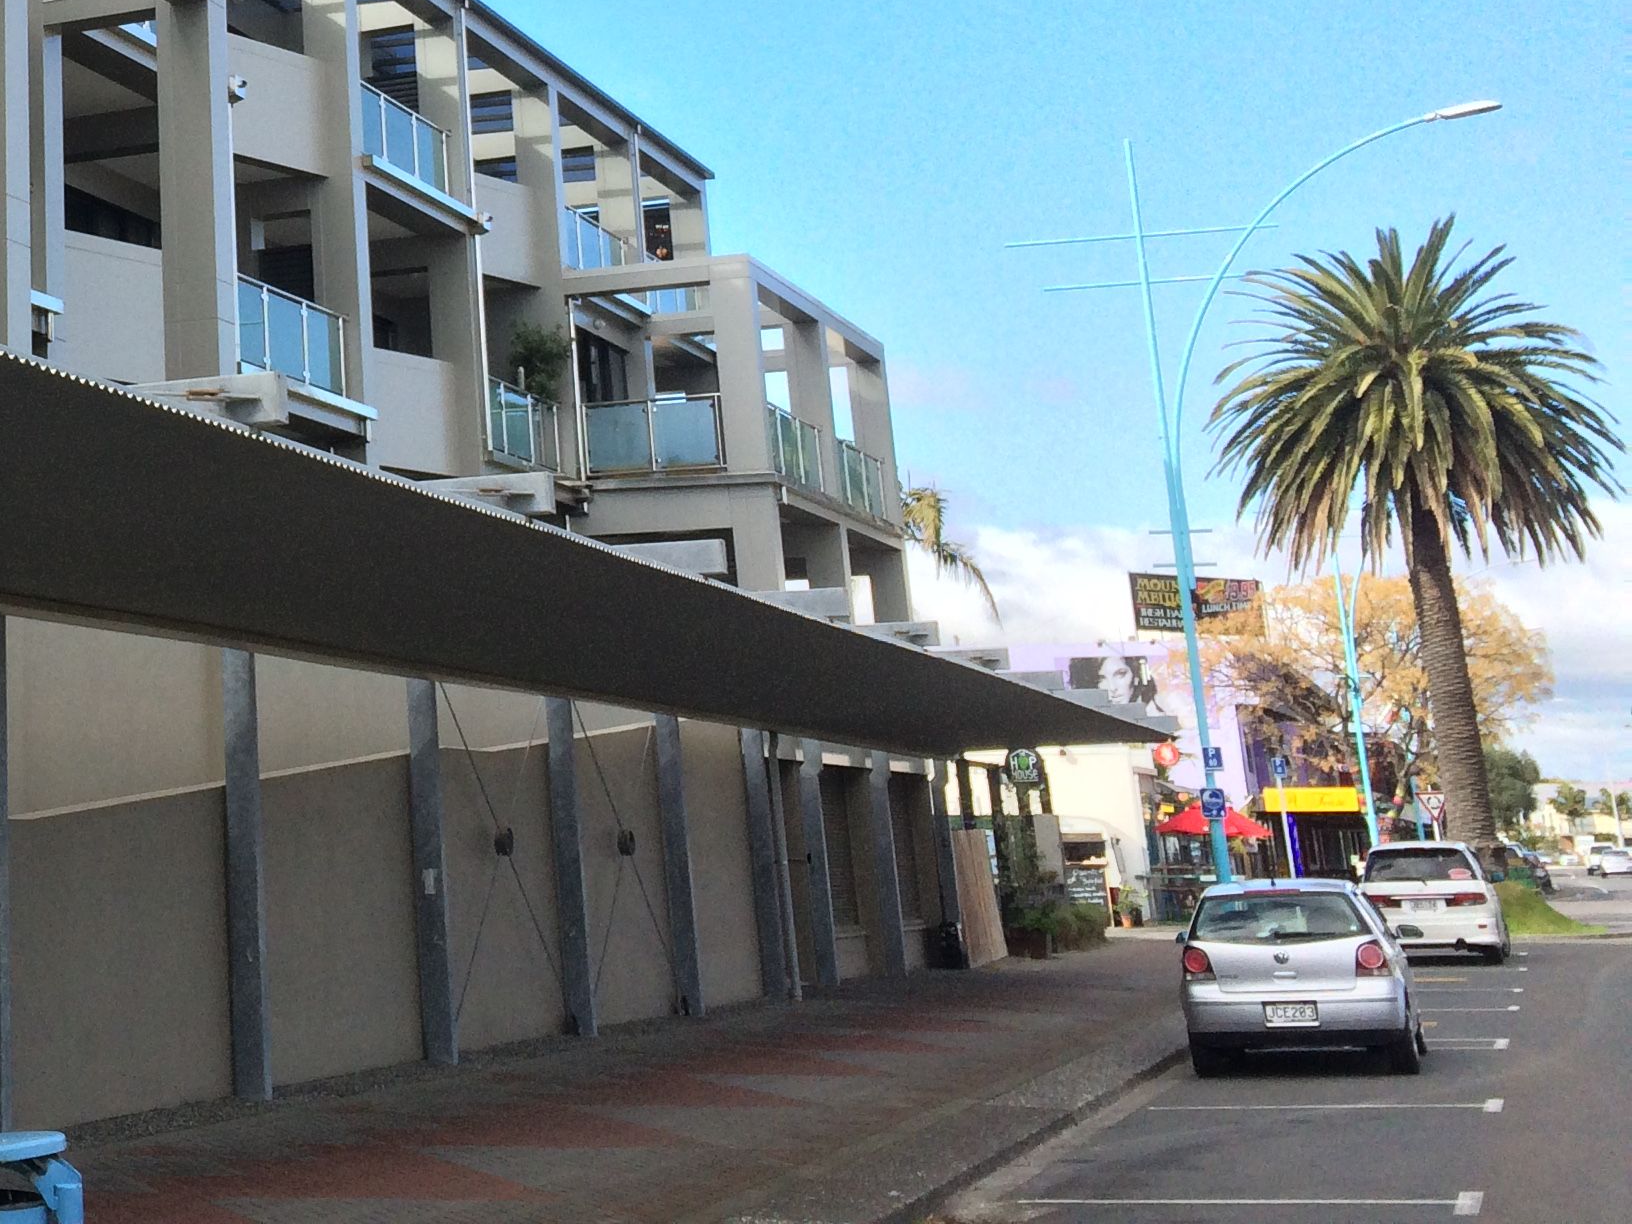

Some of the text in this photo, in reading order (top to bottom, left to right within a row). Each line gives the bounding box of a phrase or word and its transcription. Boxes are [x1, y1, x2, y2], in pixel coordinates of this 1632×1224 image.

[1202, 603, 1231, 613] LUNCH
[1140, 617, 1184, 627] RESTAURA
[1269, 1006, 1315, 1018] JCE203
